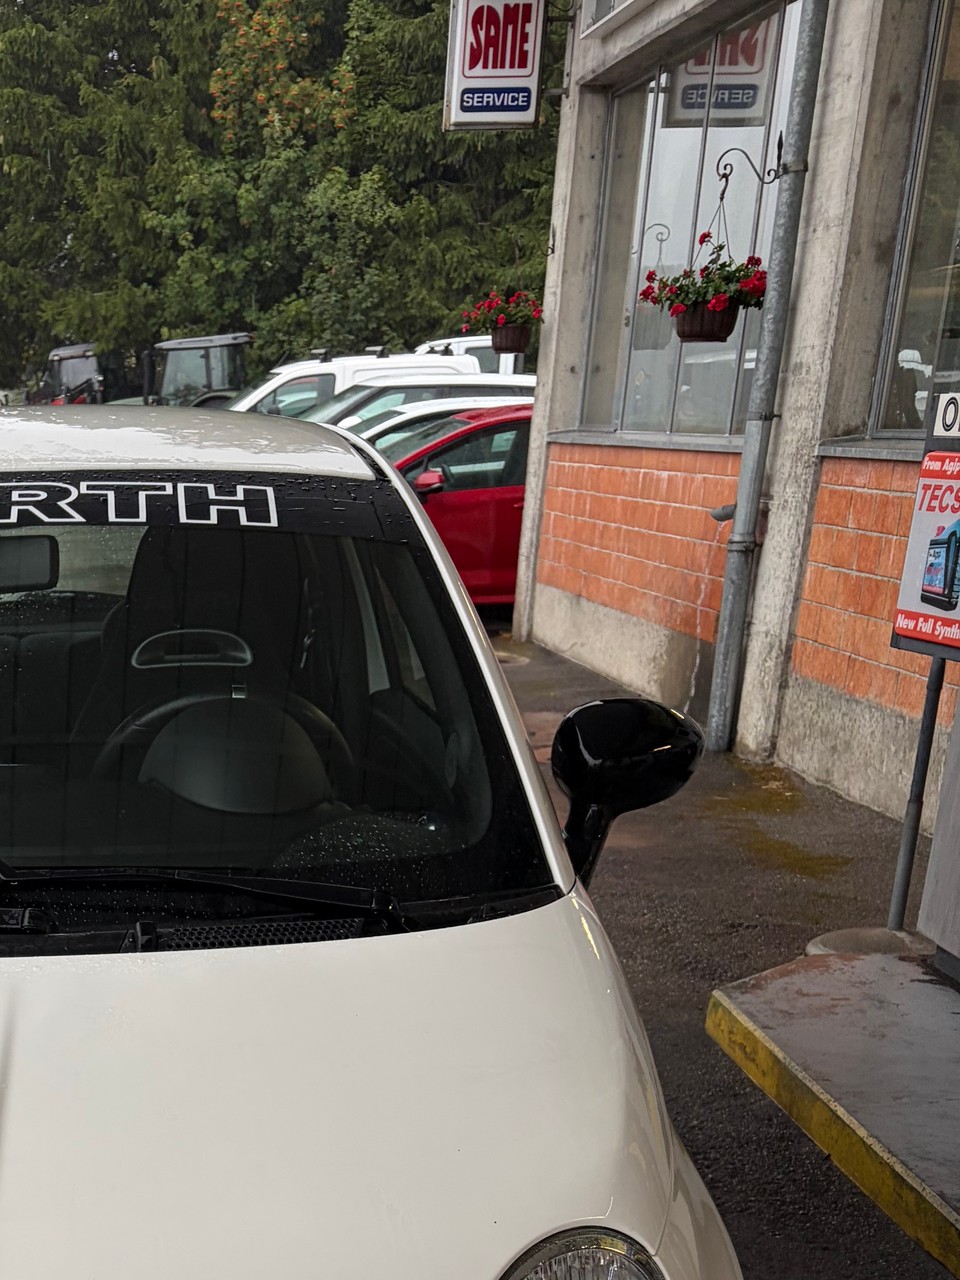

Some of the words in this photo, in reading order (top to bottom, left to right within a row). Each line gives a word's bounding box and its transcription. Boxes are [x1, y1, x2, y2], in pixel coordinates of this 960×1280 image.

[468, 3, 533, 70] SAME
[463, 92, 528, 106] SERVICE
[922, 457, 941, 470] From
[896, 613, 916, 630] New
[916, 616, 934, 634] Full
